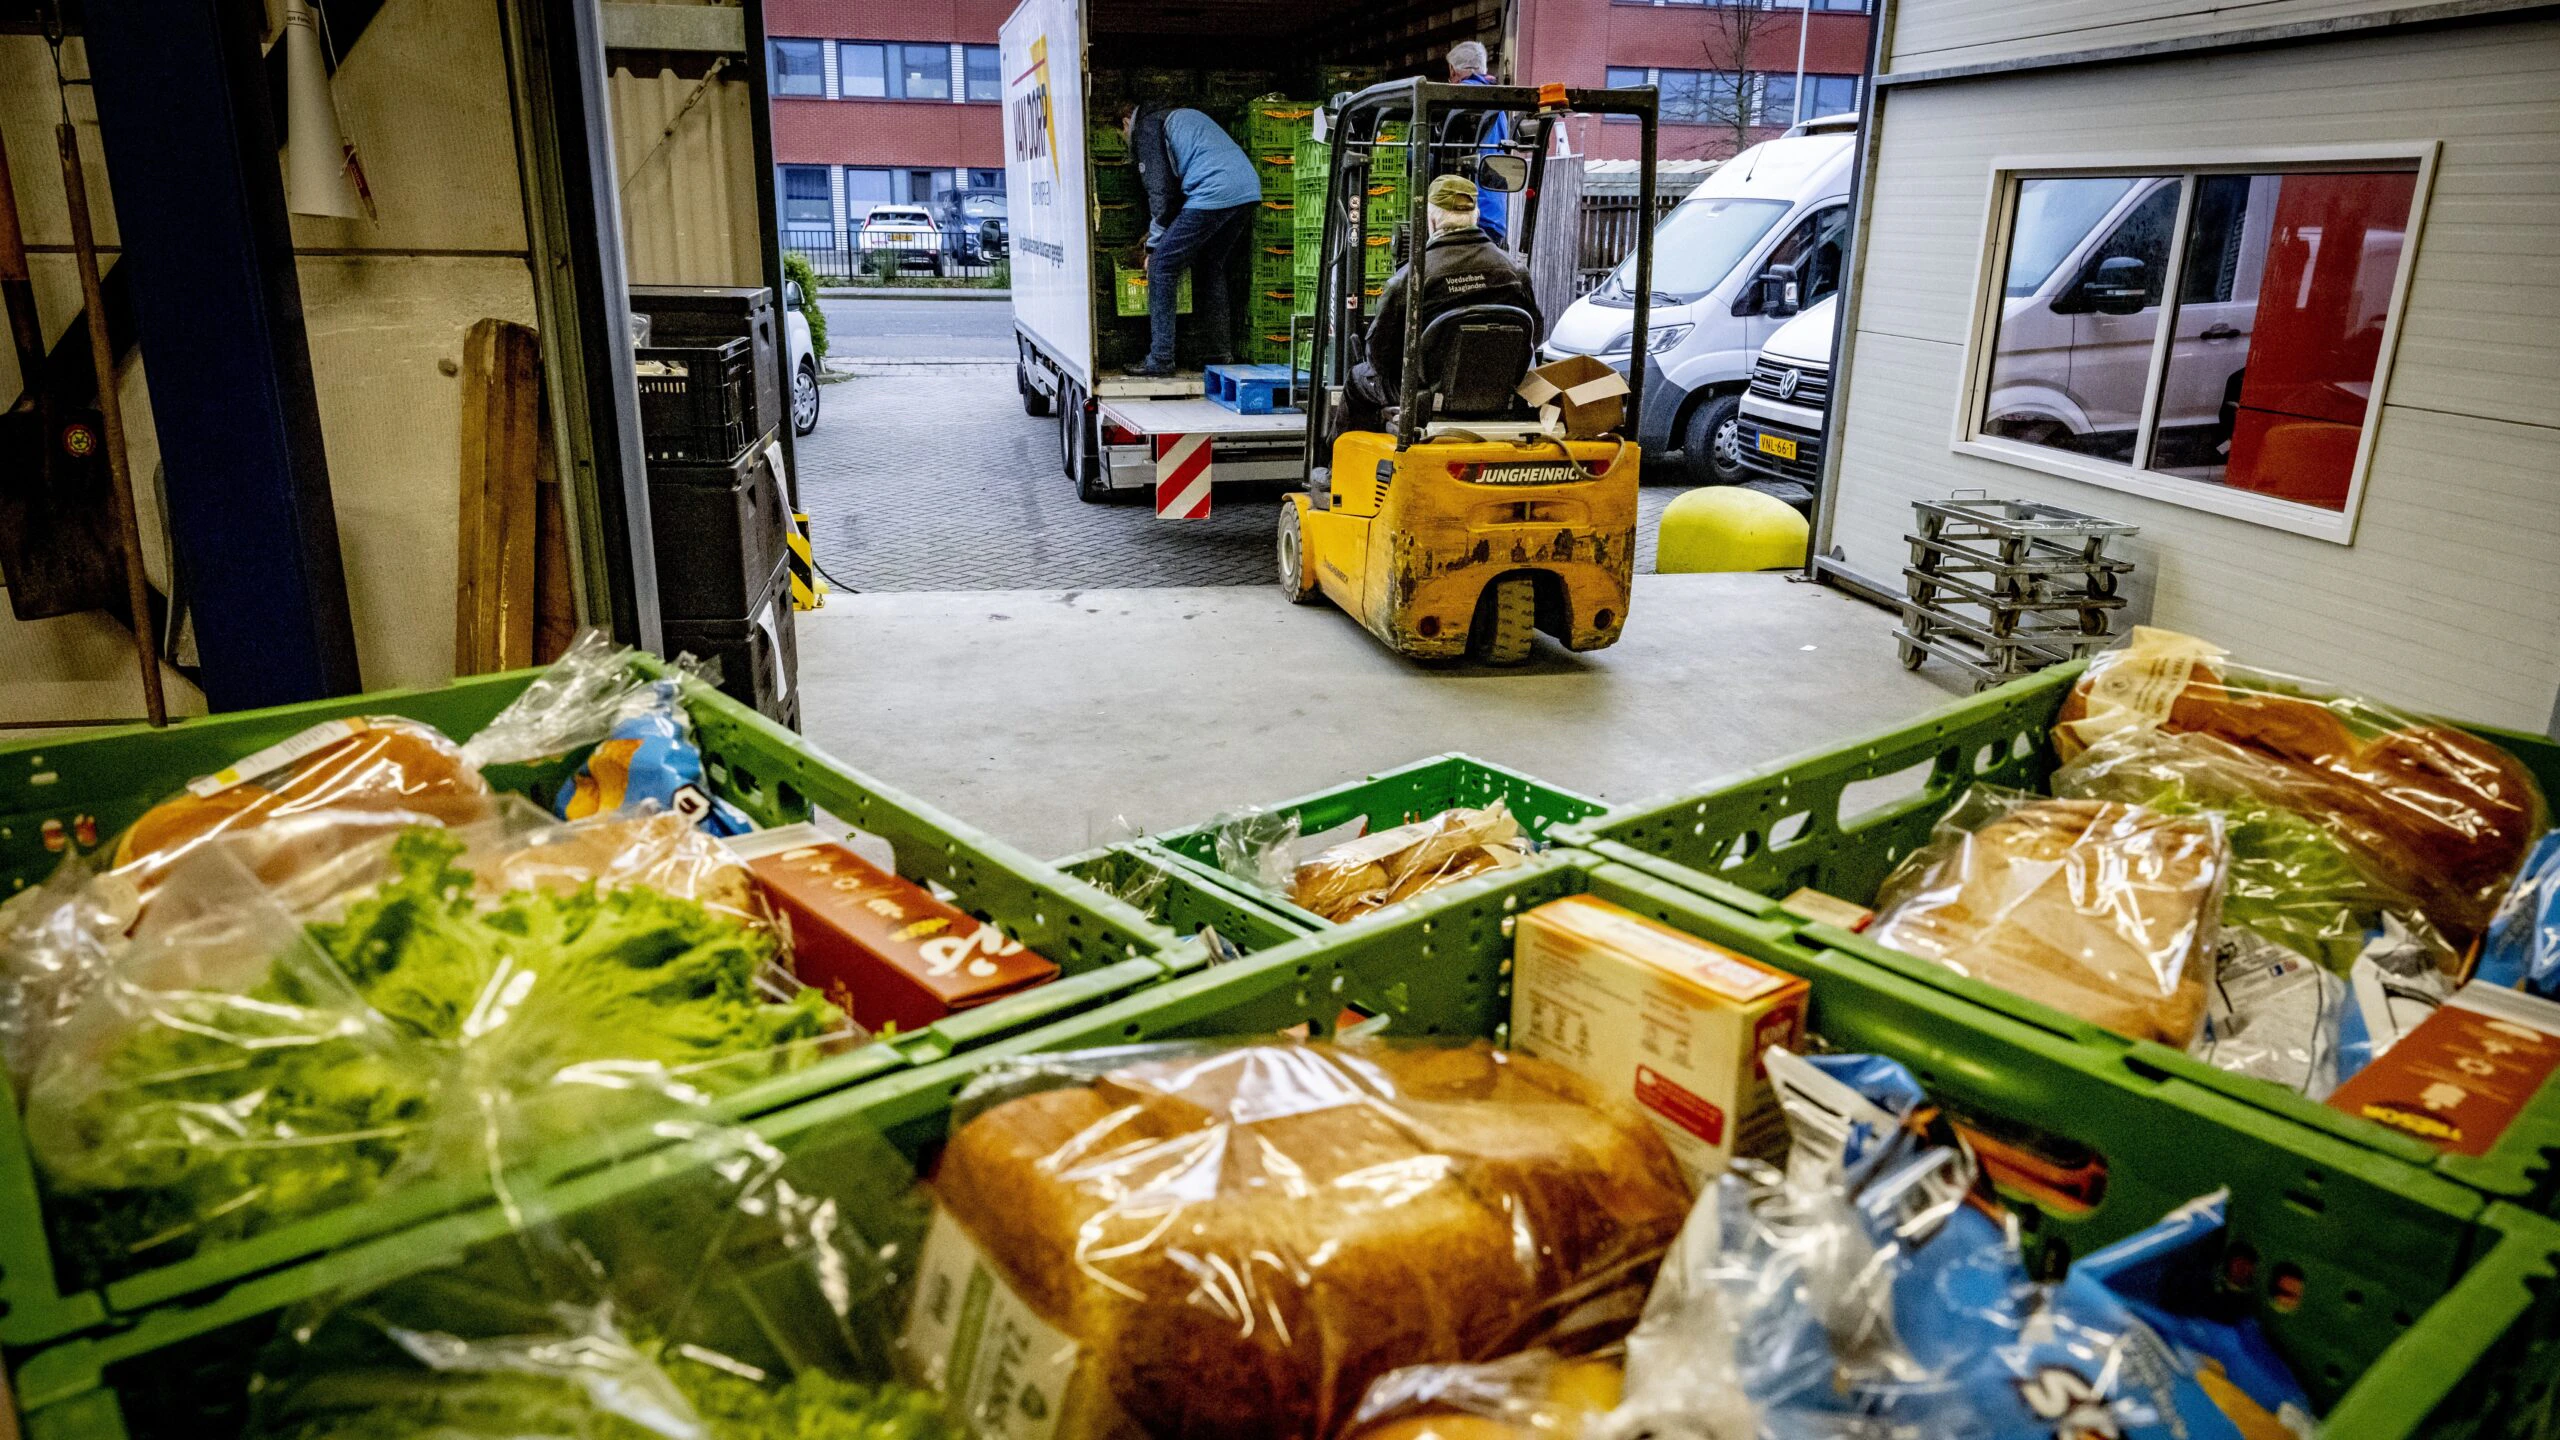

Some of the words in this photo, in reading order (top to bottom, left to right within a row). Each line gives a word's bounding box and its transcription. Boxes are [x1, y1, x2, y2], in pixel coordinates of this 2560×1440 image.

[1013, 95, 1028, 163] VAN
[1027, 83, 1048, 160] DORP
[1445, 273, 1486, 285] Voedselbank
[1448, 282, 1487, 293] Haaglanden
[1761, 437, 1794, 457] VNL-66-T
